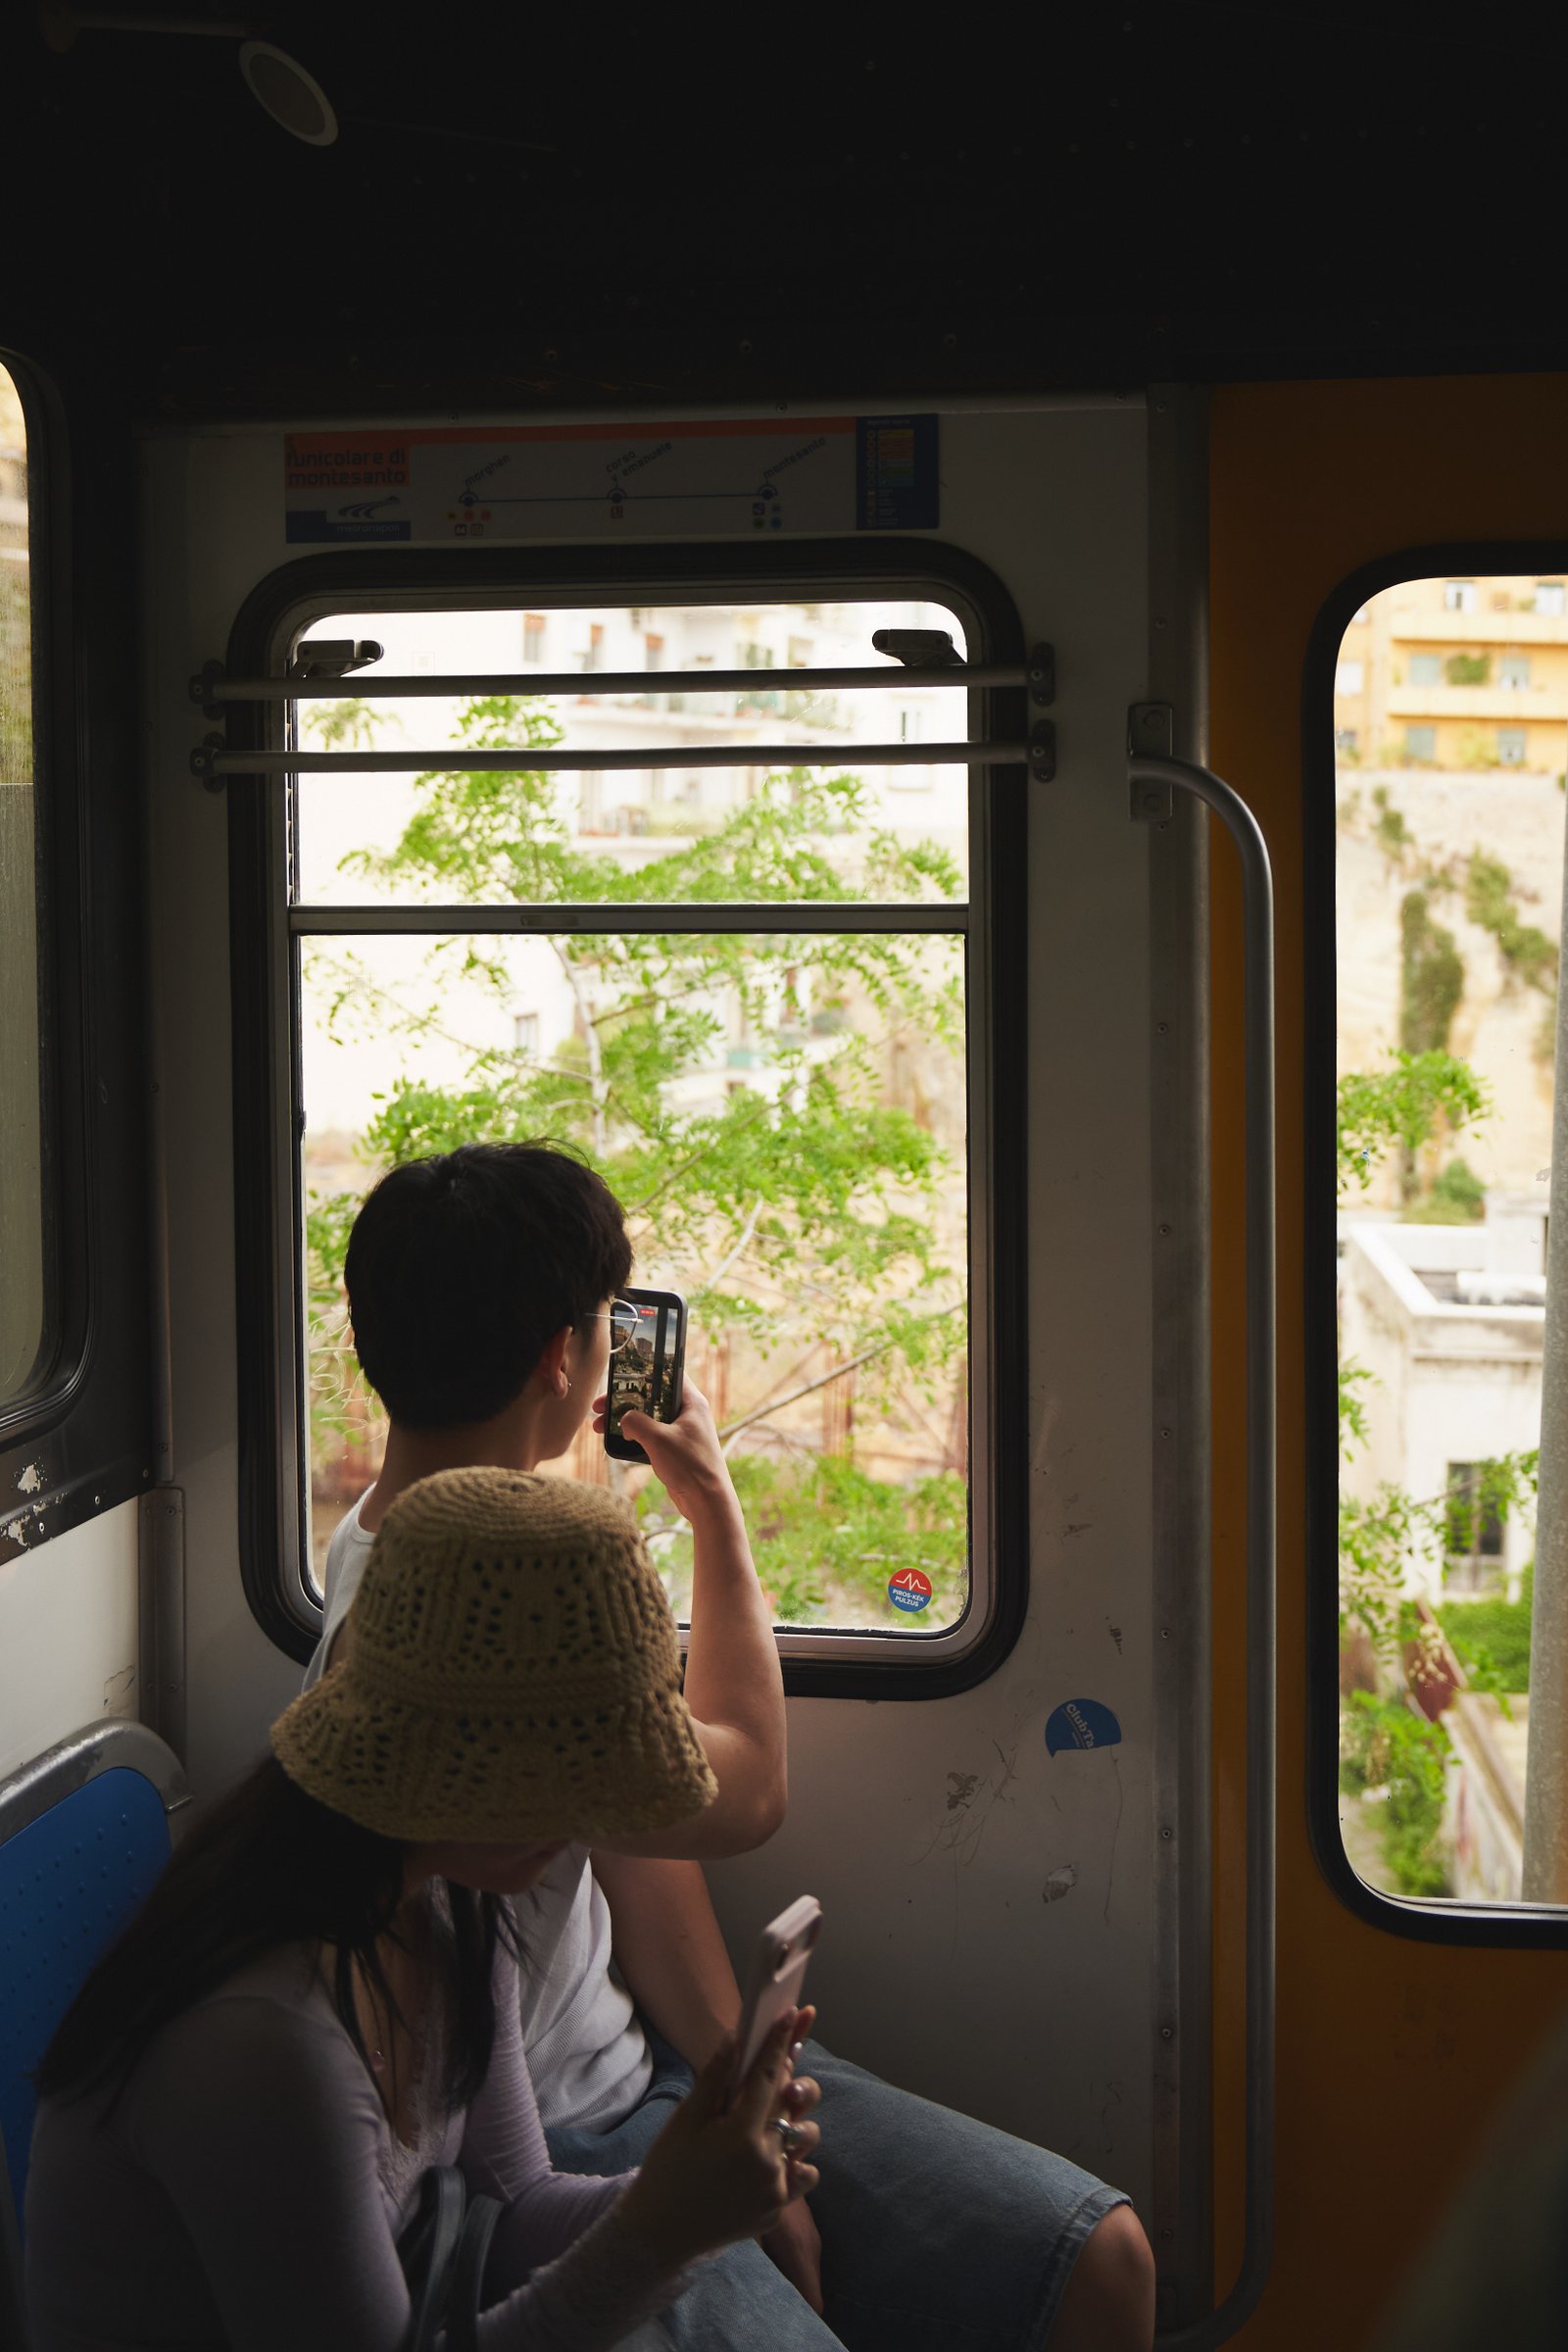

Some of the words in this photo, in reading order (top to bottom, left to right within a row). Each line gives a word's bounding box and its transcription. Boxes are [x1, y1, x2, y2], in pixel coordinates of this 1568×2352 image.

[389, 447, 406, 465] di
[606, 451, 636, 472] corso
[288, 467, 406, 486] montesanto
[336, 523, 400, 534] metronapoli
[894, 1595, 920, 1607] PULZUS
